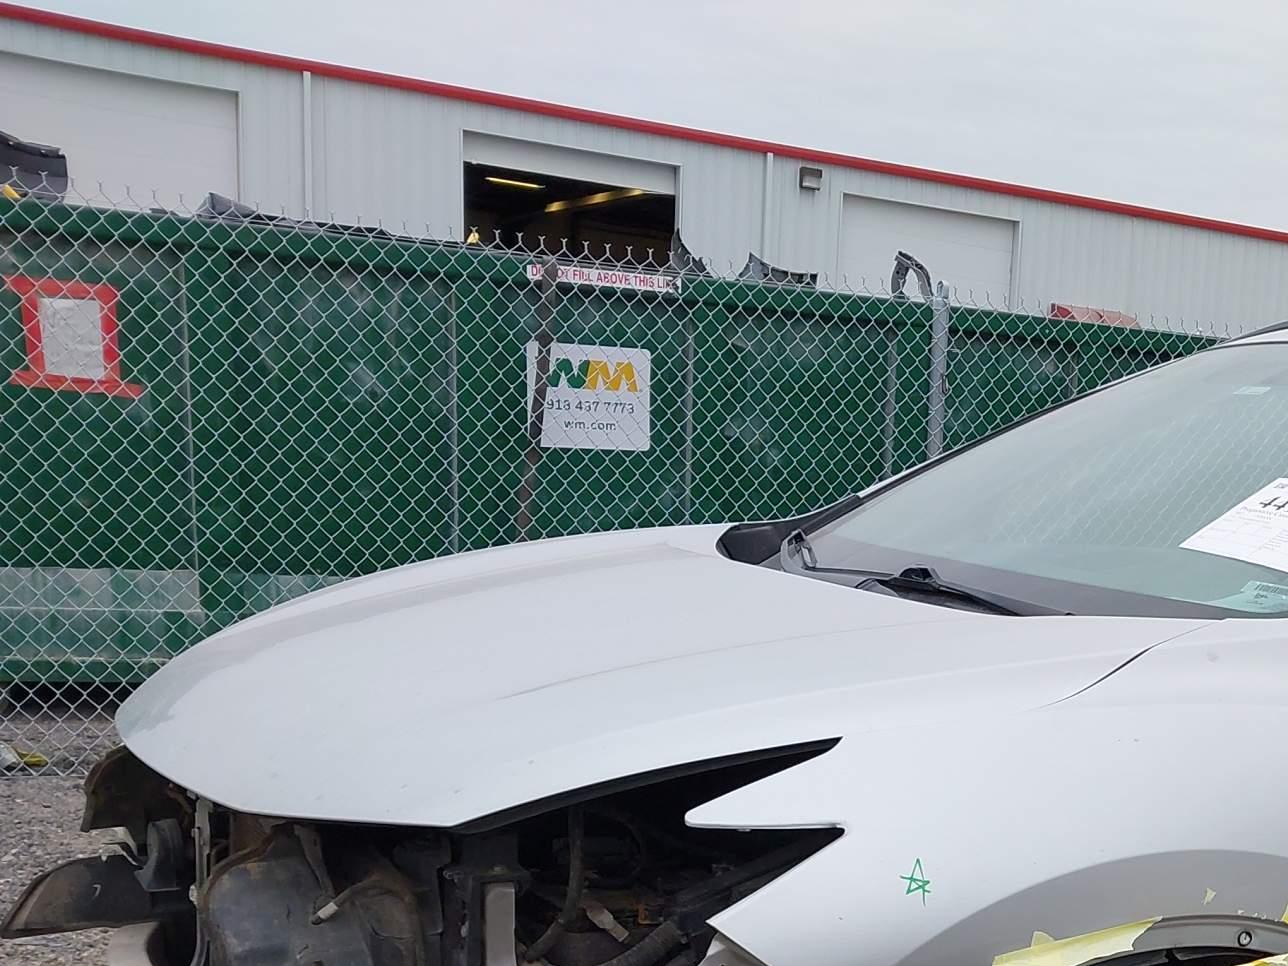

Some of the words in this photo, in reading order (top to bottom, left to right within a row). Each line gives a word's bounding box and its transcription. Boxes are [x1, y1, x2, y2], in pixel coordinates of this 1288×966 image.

[573, 269, 593, 282] FILL
[596, 272, 631, 285] ABOVE
[634, 275, 654, 288] THIS
[575, 400, 600, 413] 437
[563, 420, 616, 431] wm.com
